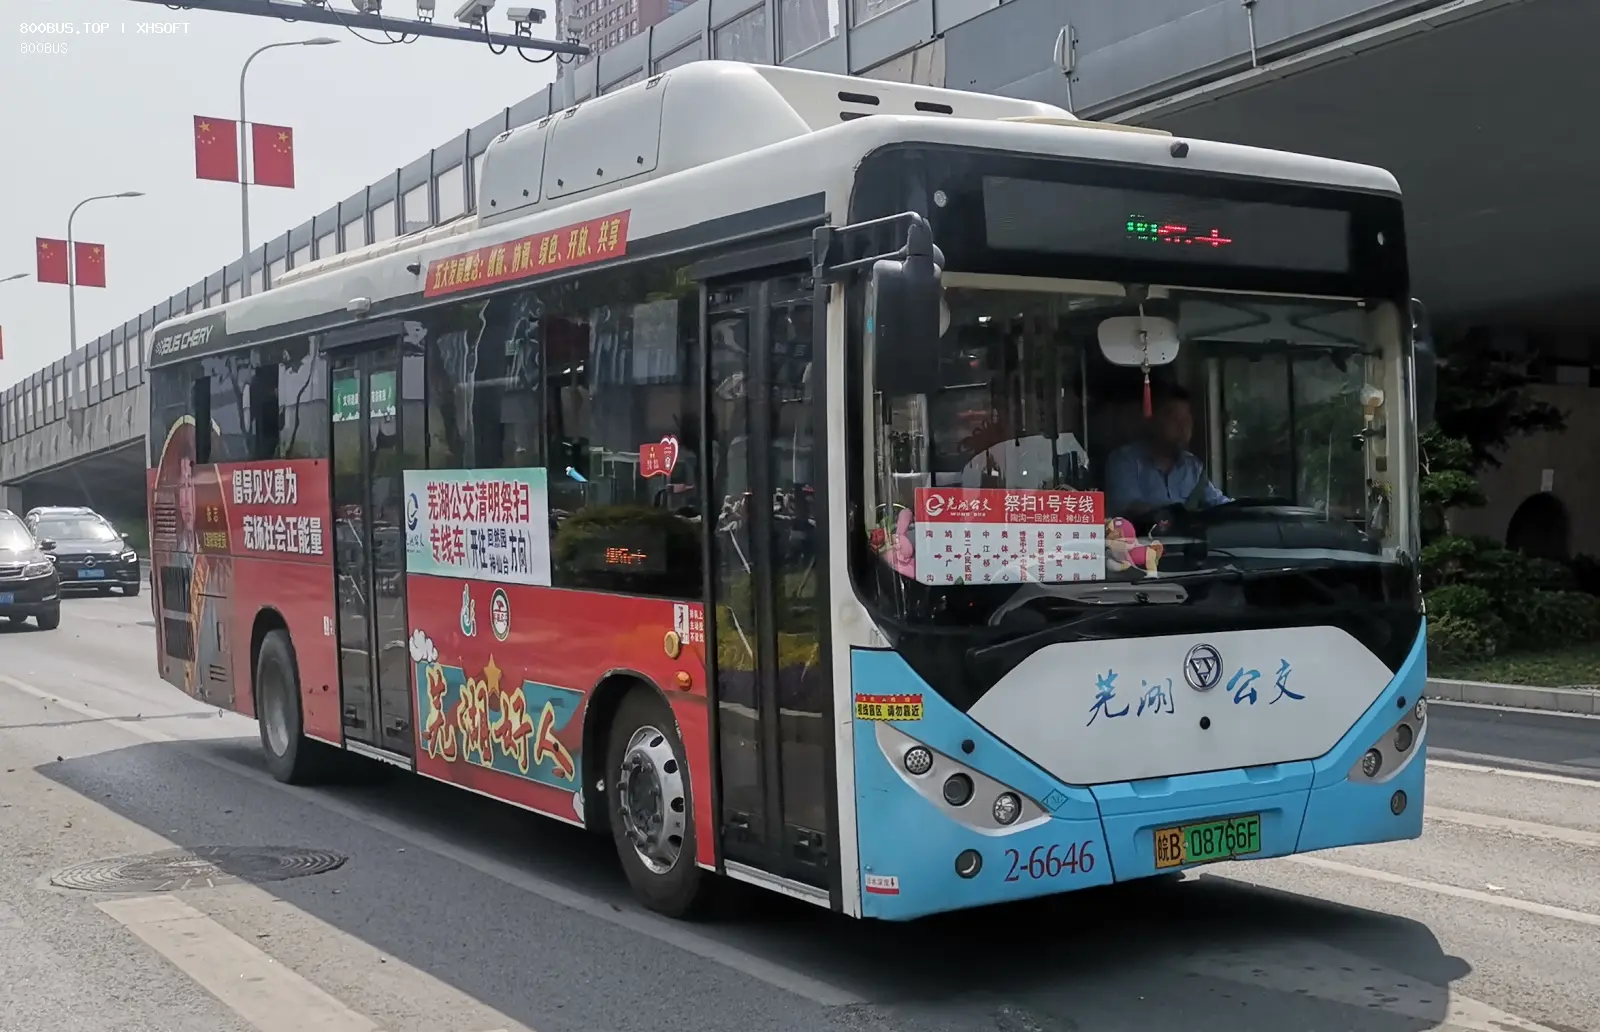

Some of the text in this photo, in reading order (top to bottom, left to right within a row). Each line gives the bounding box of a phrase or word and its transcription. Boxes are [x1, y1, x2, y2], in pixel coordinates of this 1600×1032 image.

[232, 467, 298, 505] 倡导见义勇为
[427, 480, 531, 524] 芜湖公交清明祭扫
[1004, 493, 1094, 513] 祭扫1号专线
[243, 515, 324, 555] 宏扬社会正能量
[1001, 530, 1009, 582] 奥体中心
[1086, 658, 1306, 727] 芜湖 公交
[425, 663, 575, 783] 芜湖好人
[1190, 820, 1258, 857] 08766F
[1003, 840, 1096, 882] 2-6646
